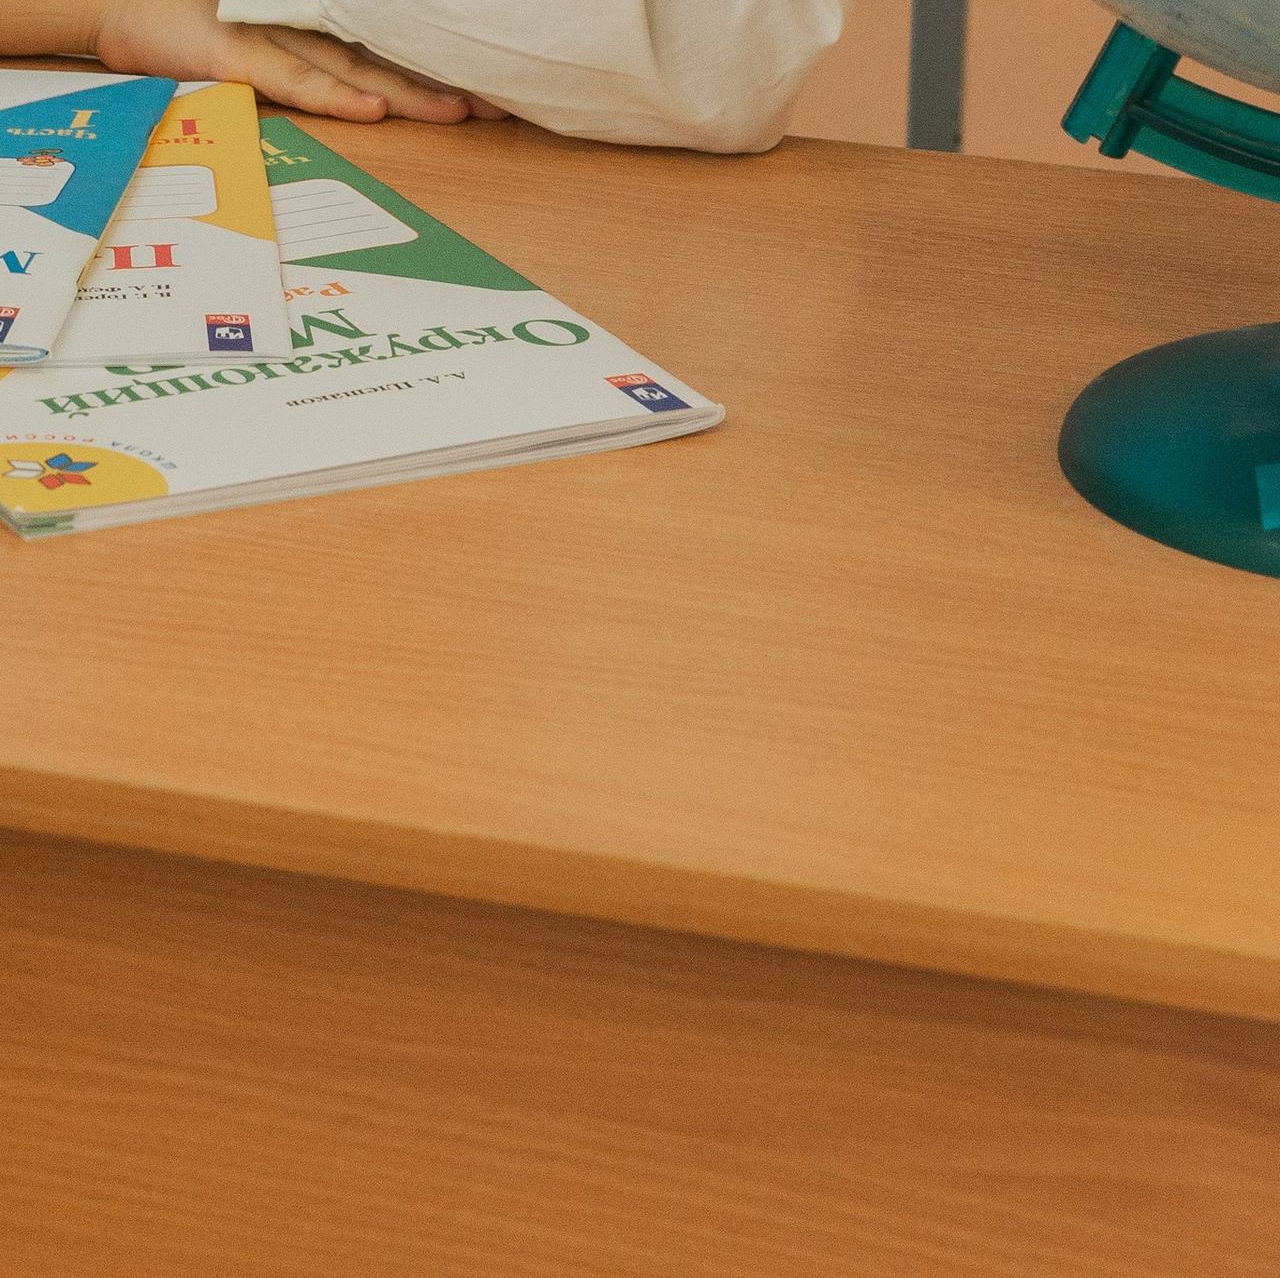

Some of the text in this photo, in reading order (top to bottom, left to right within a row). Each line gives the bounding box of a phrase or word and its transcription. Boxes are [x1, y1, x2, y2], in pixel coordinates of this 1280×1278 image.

[69, 109, 101, 129] 1
[170, 119, 206, 137] 1
[6, 127, 97, 141] Часть
[35, 317, 593, 420] Окружающий
[285, 380, 416, 409] Плешаков
[110, 440, 179, 472] ШКОЛА
